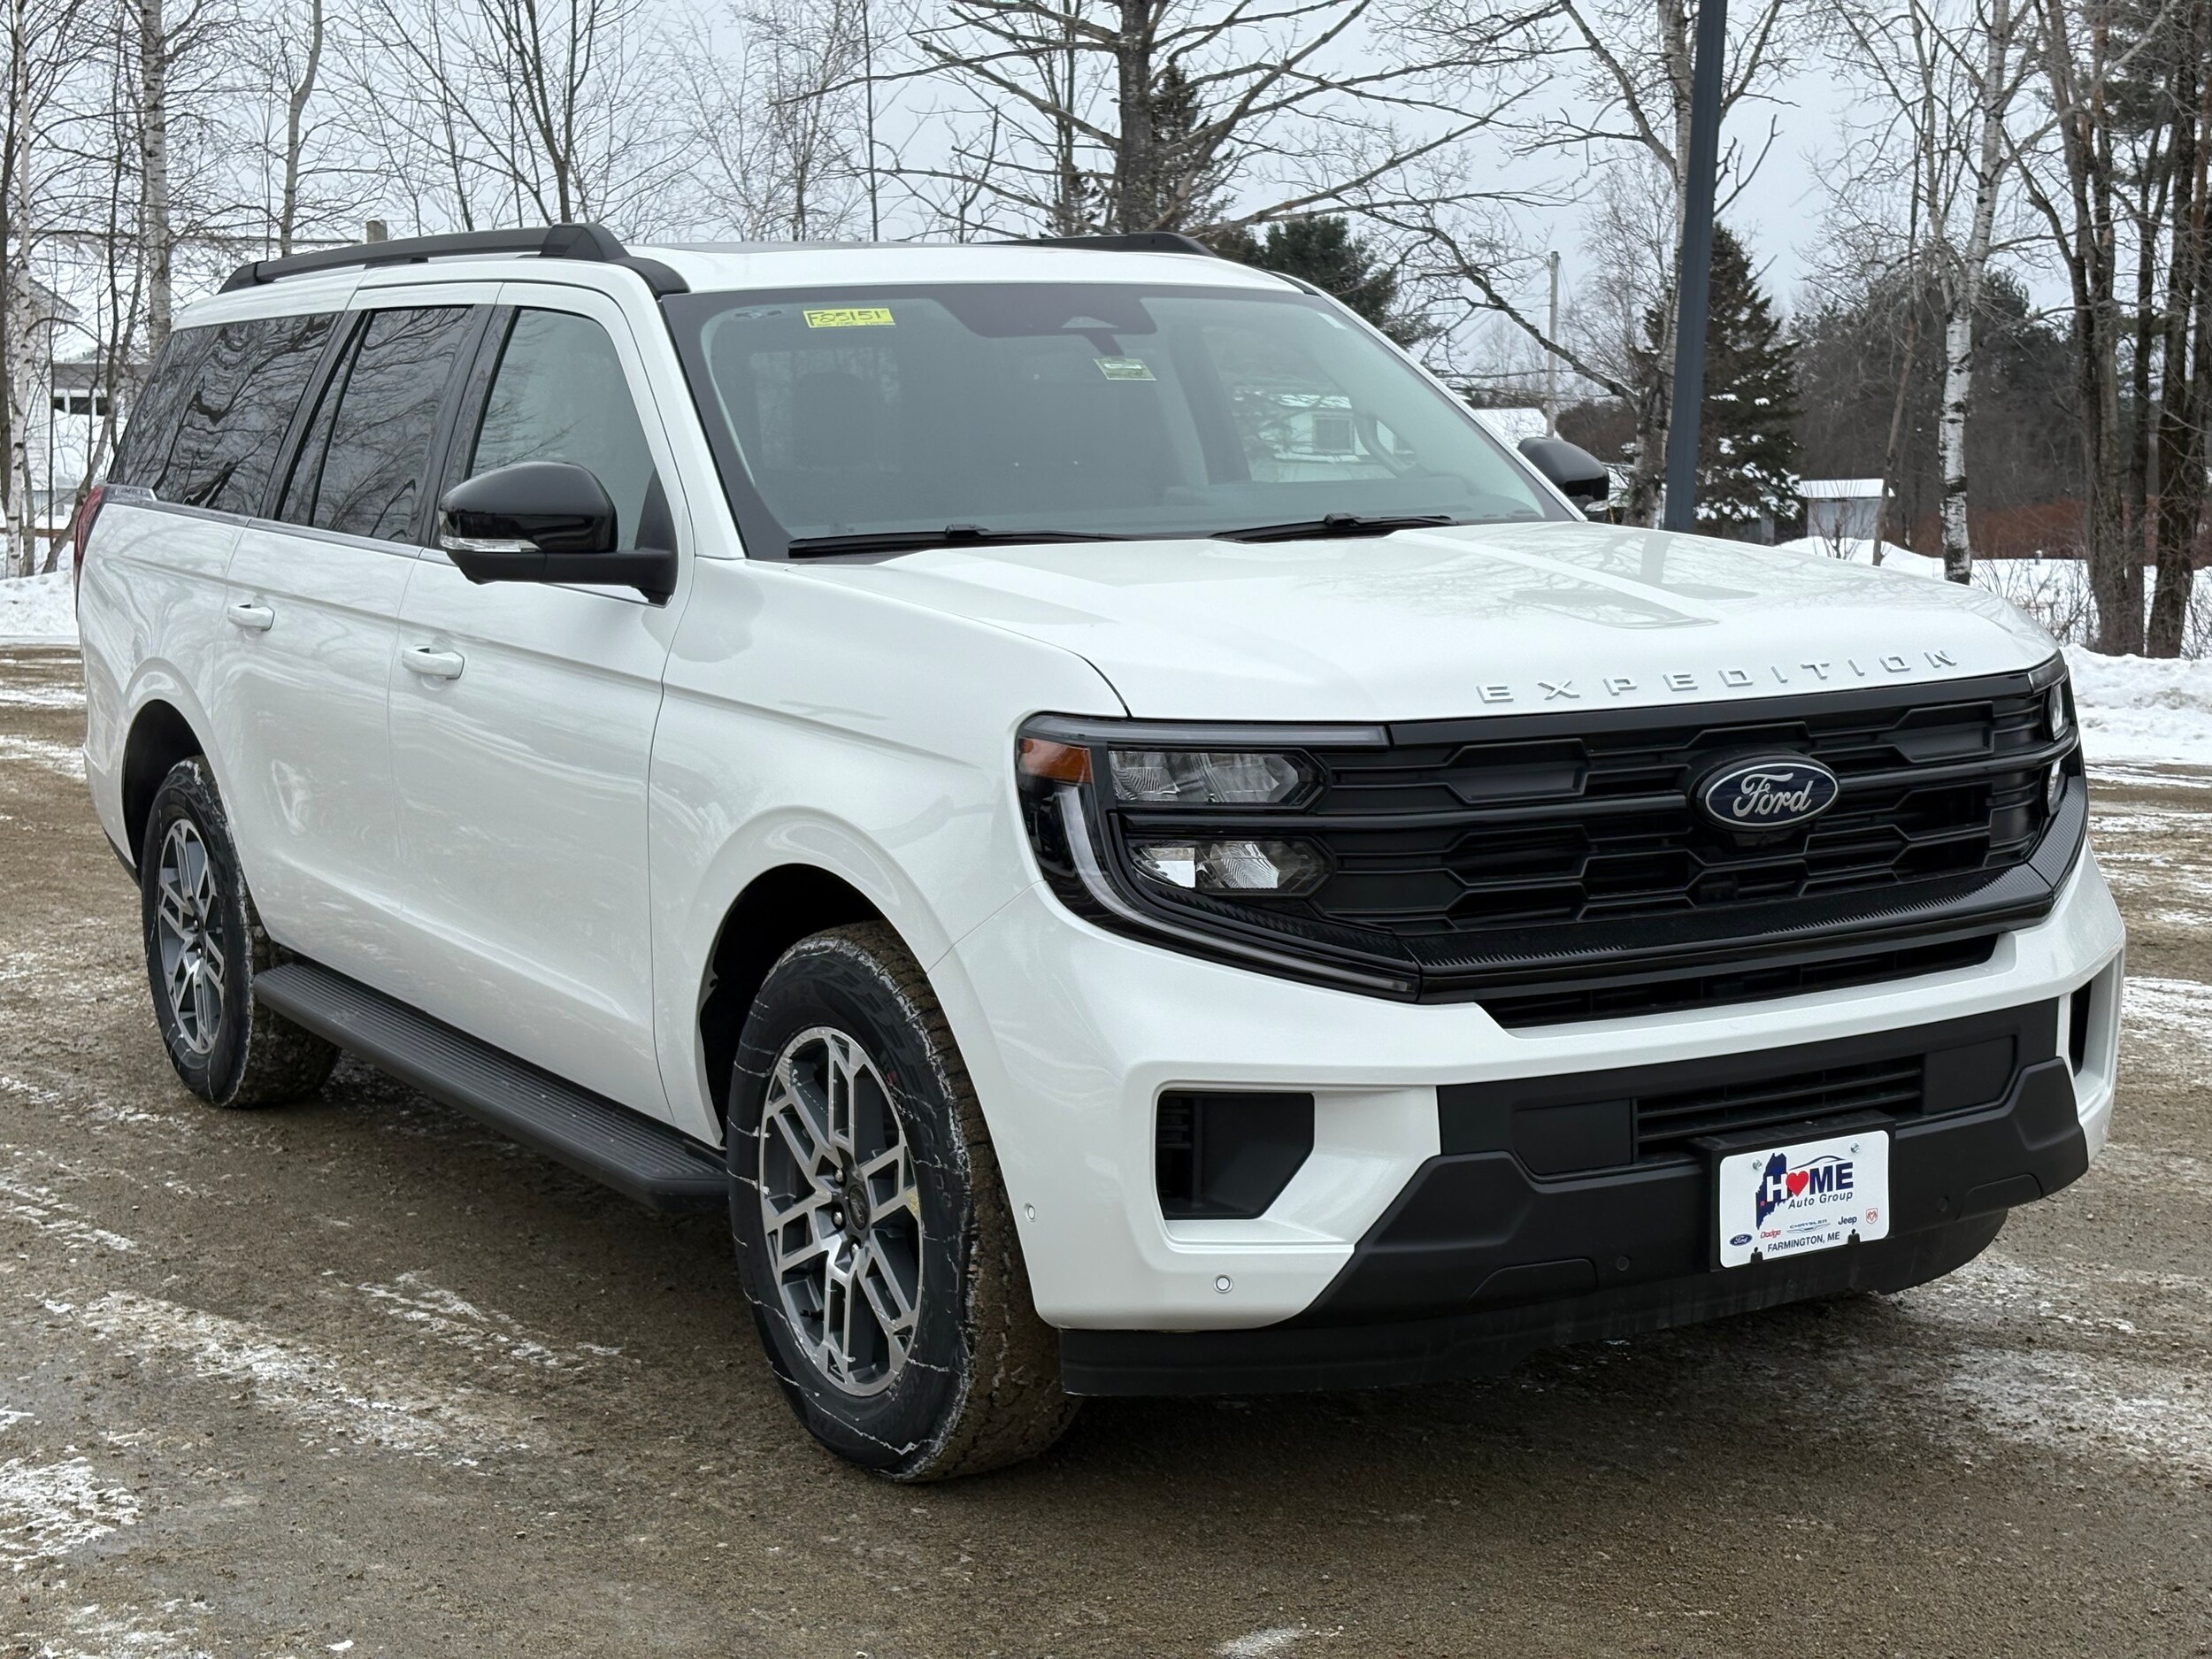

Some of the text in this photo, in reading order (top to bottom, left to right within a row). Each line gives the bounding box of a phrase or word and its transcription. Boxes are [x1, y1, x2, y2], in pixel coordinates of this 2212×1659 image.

[1475, 649, 1957, 703] EXPEDITION
[1732, 772, 1812, 818] Ford
[1787, 1191, 1854, 1210] Auto Group
[1789, 1218, 1828, 1229] CHRYSLER
[1838, 1216, 1857, 1225] Jeep
[1760, 1229, 1782, 1239] Dodge
[1767, 1232, 1840, 1253] FARMINGTON, ME
